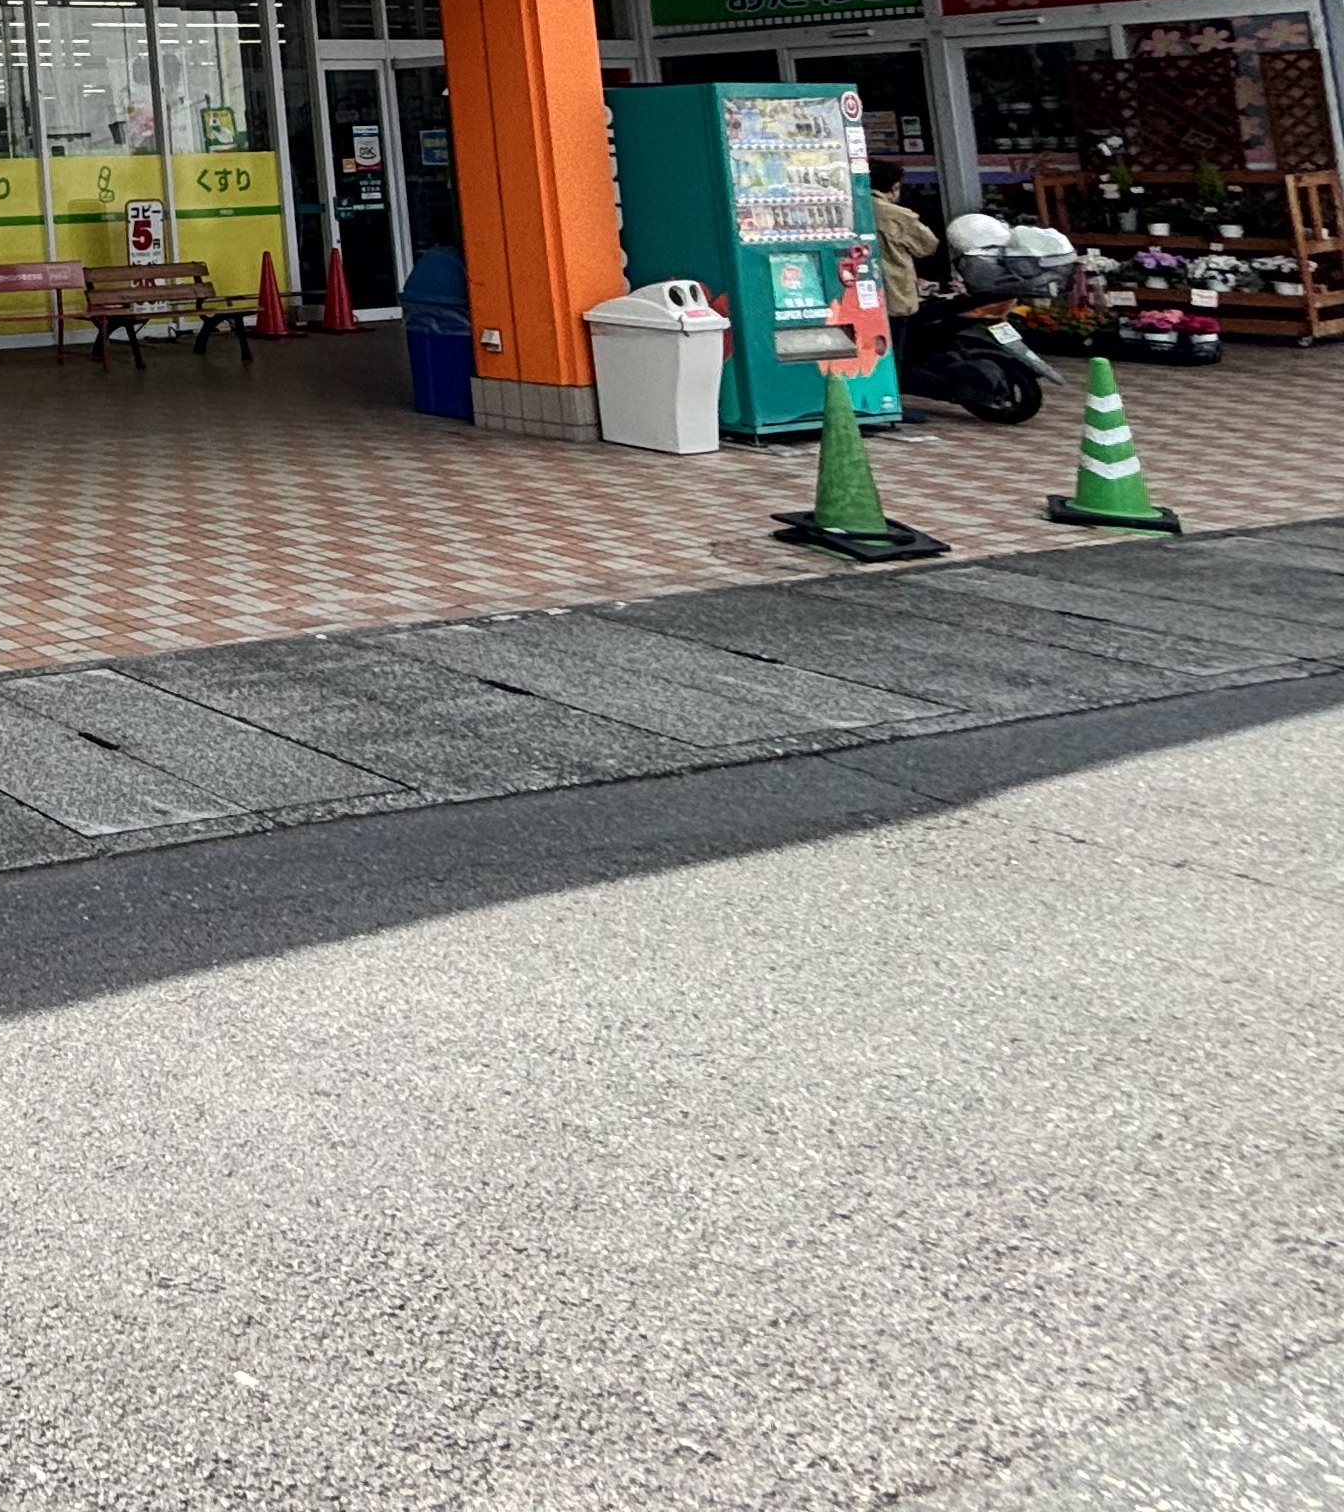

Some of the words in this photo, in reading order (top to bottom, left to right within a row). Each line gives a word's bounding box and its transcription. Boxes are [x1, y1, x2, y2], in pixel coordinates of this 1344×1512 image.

[197, 168, 251, 192] くすり
[130, 205, 161, 219] コピー
